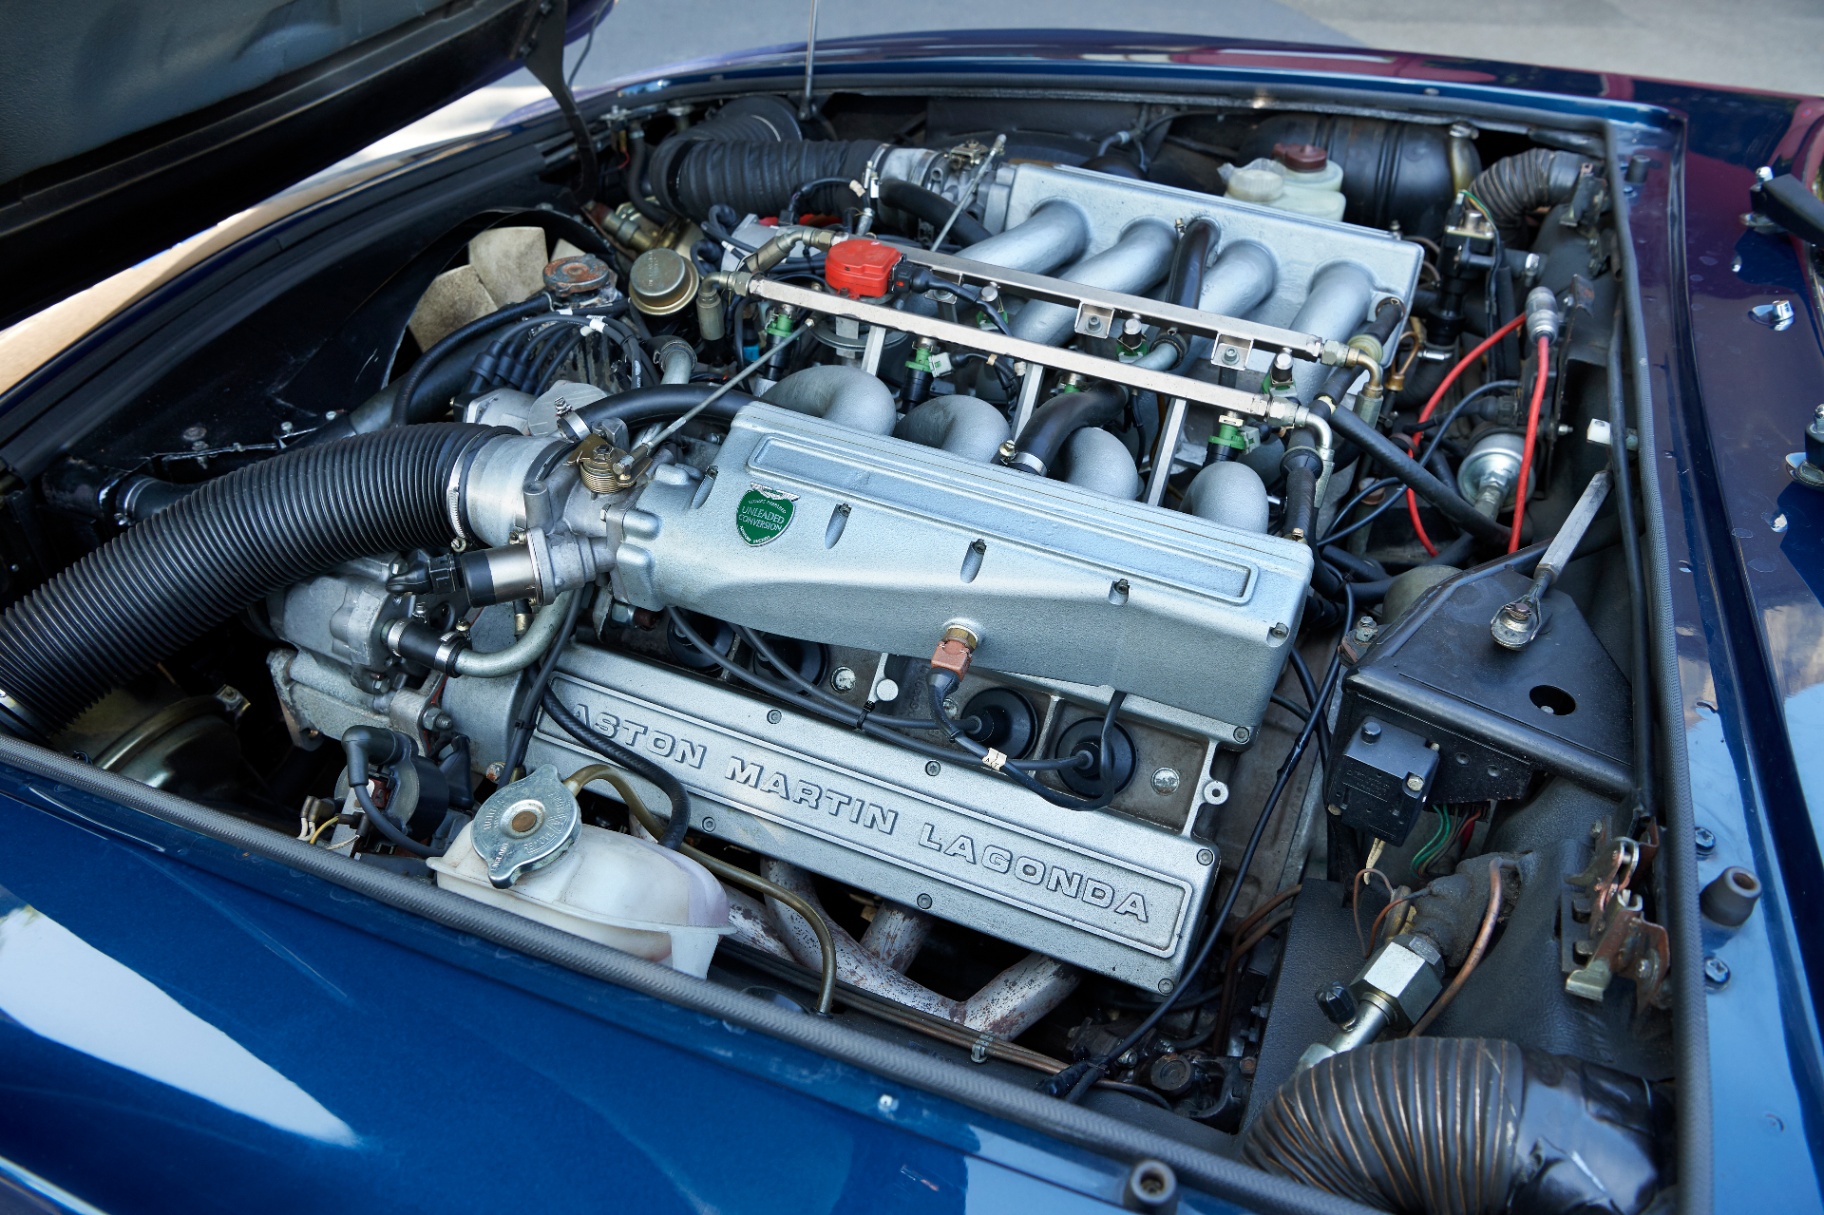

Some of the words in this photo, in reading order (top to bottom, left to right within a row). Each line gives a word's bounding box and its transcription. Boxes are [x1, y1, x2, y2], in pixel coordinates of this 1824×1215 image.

[739, 514, 783, 532] CONVERSION
[742, 505, 785, 525] UNLEADED
[572, 703, 708, 769] ASTON
[724, 756, 899, 836] MARTIN
[918, 822, 1149, 923] LAGONDA
